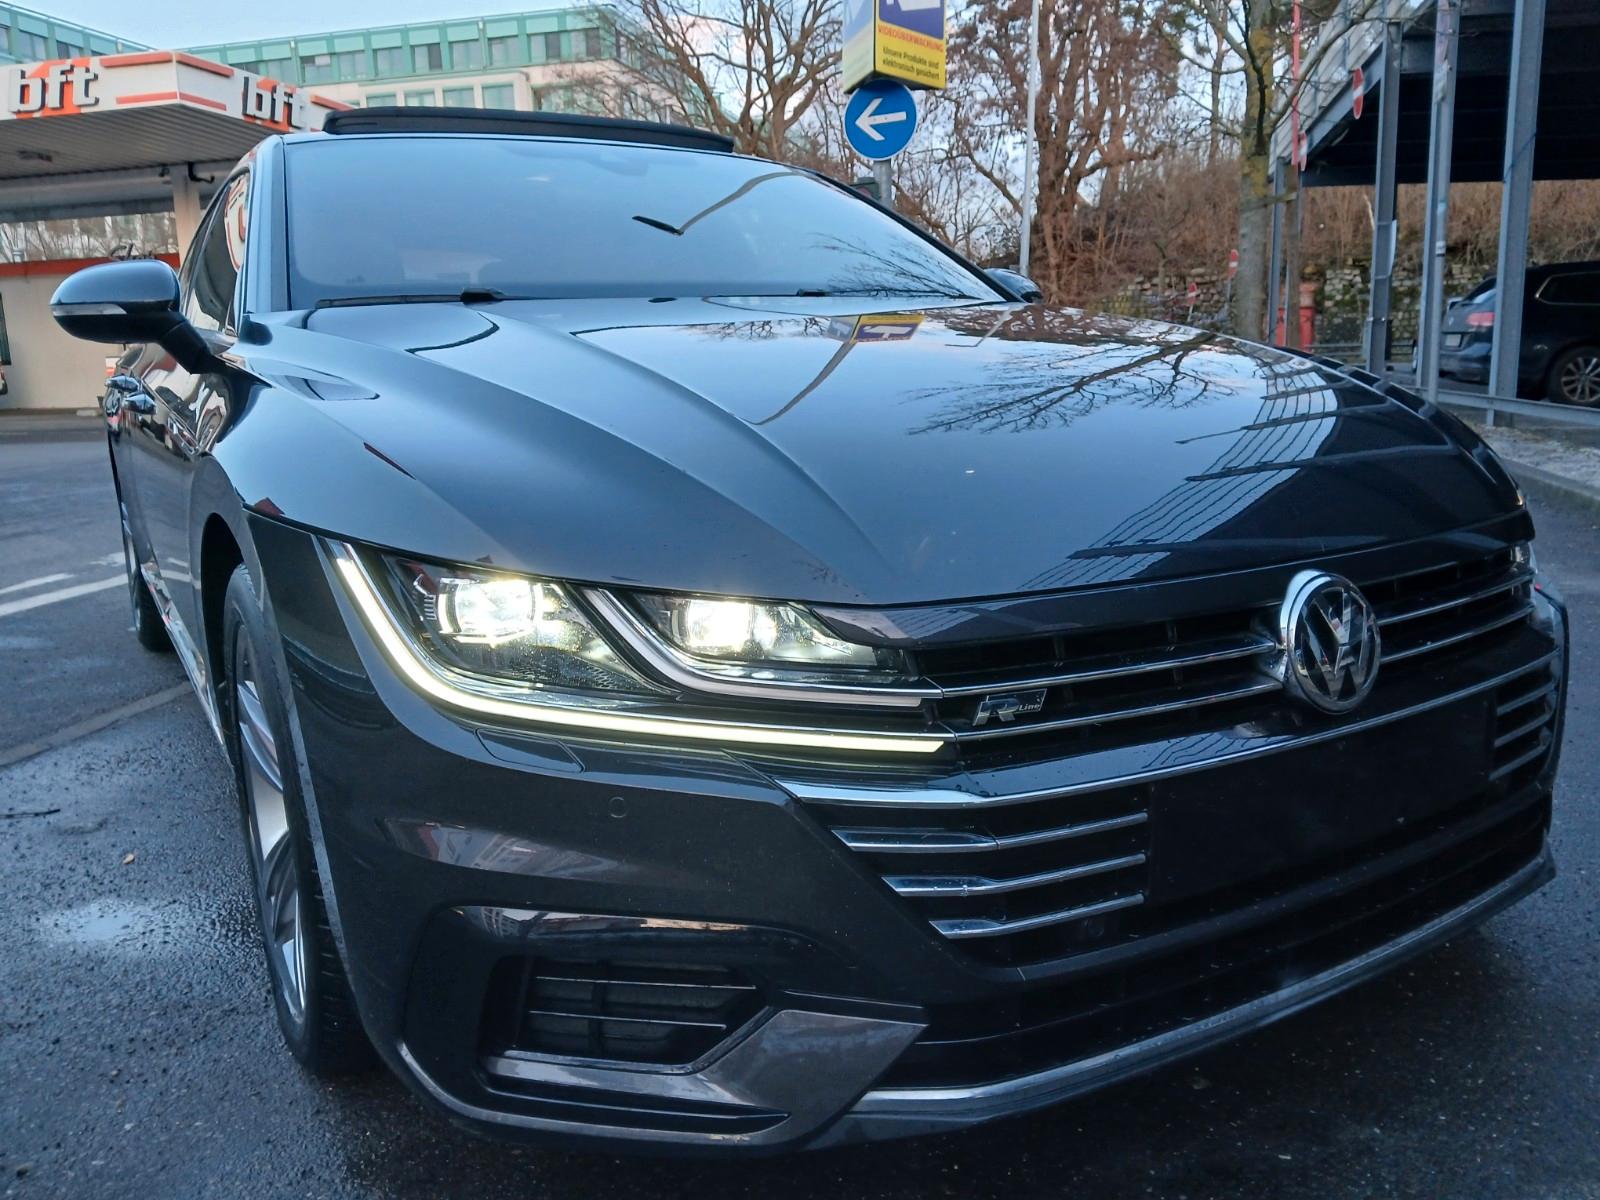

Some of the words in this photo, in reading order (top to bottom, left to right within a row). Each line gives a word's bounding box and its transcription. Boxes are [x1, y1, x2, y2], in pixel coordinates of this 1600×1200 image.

[883, 58, 915, 72] elektronisch
[903, 52, 927, 66] Produkte
[8, 61, 99, 112] bft
[241, 76, 303, 129] bft
[972, 695, 1018, 727] R
[1019, 703, 1041, 712] Line
